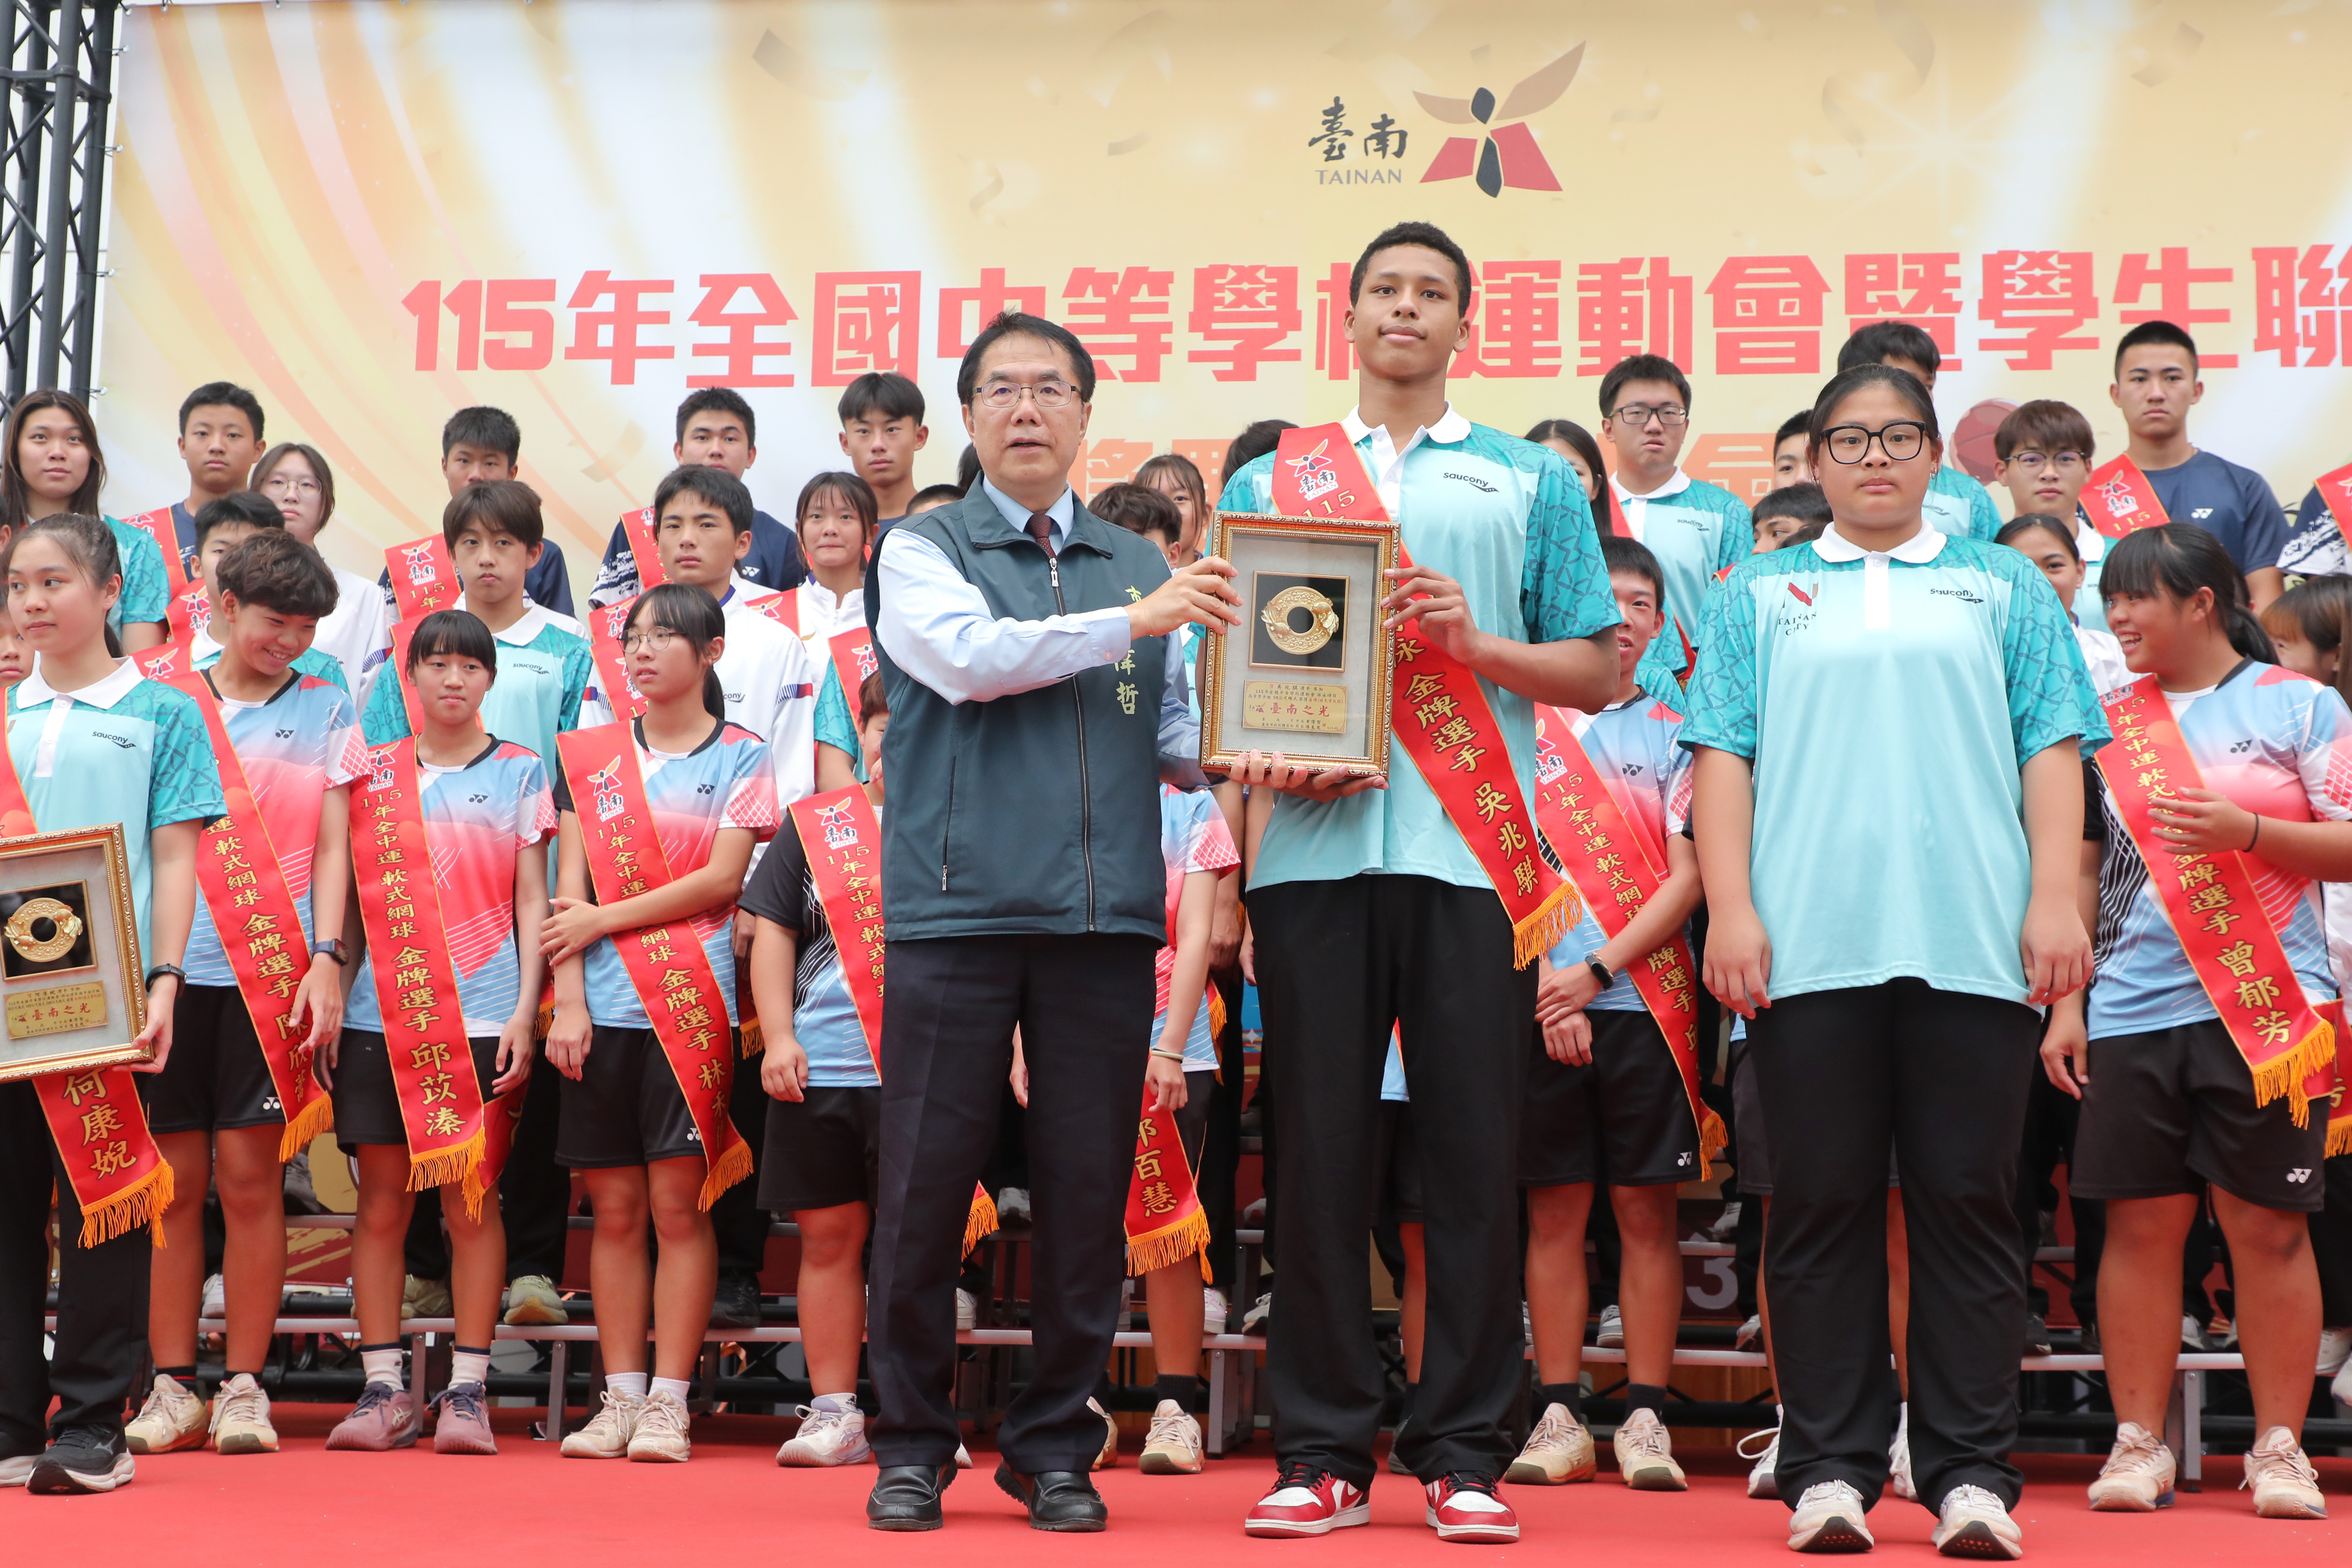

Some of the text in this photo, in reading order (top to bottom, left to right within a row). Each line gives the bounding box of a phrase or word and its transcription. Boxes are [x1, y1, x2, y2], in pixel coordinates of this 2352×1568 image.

[1308, 95, 1409, 162] 臺南
[1315, 168, 1403, 186] TAINAN
[1443, 471, 1489, 487] saucony
[1306, 482, 1338, 498] TAINAN
[1677, 519, 1704, 528] saucony
[1930, 588, 1974, 598] saucony
[1270, 702, 1330, 717] 臺南之光
[92, 731, 128, 744] saucony
[1542, 767, 1567, 783] TAINAN
[369, 782, 393, 791] TAINAN
[1403, 671, 1486, 773] 金牌選手
[1475, 781, 1538, 898] 吳兆騏
[601, 807, 624, 820] TAINAN
[831, 838, 858, 848] TAINAN
[380, 868, 419, 939] 軟式網球
[214, 836, 266, 908] 軟式網球
[242, 913, 302, 999] 金牌選手
[392, 946, 441, 1032] 金牌選手
[2216, 940, 2293, 1049] 曾郁芳
[32, 1003, 90, 1021] 臺南之光
[658, 968, 719, 1051] 金牌選手
[411, 1042, 466, 1136] 邱苡溱
[1685, 1257, 1738, 1310] 3
